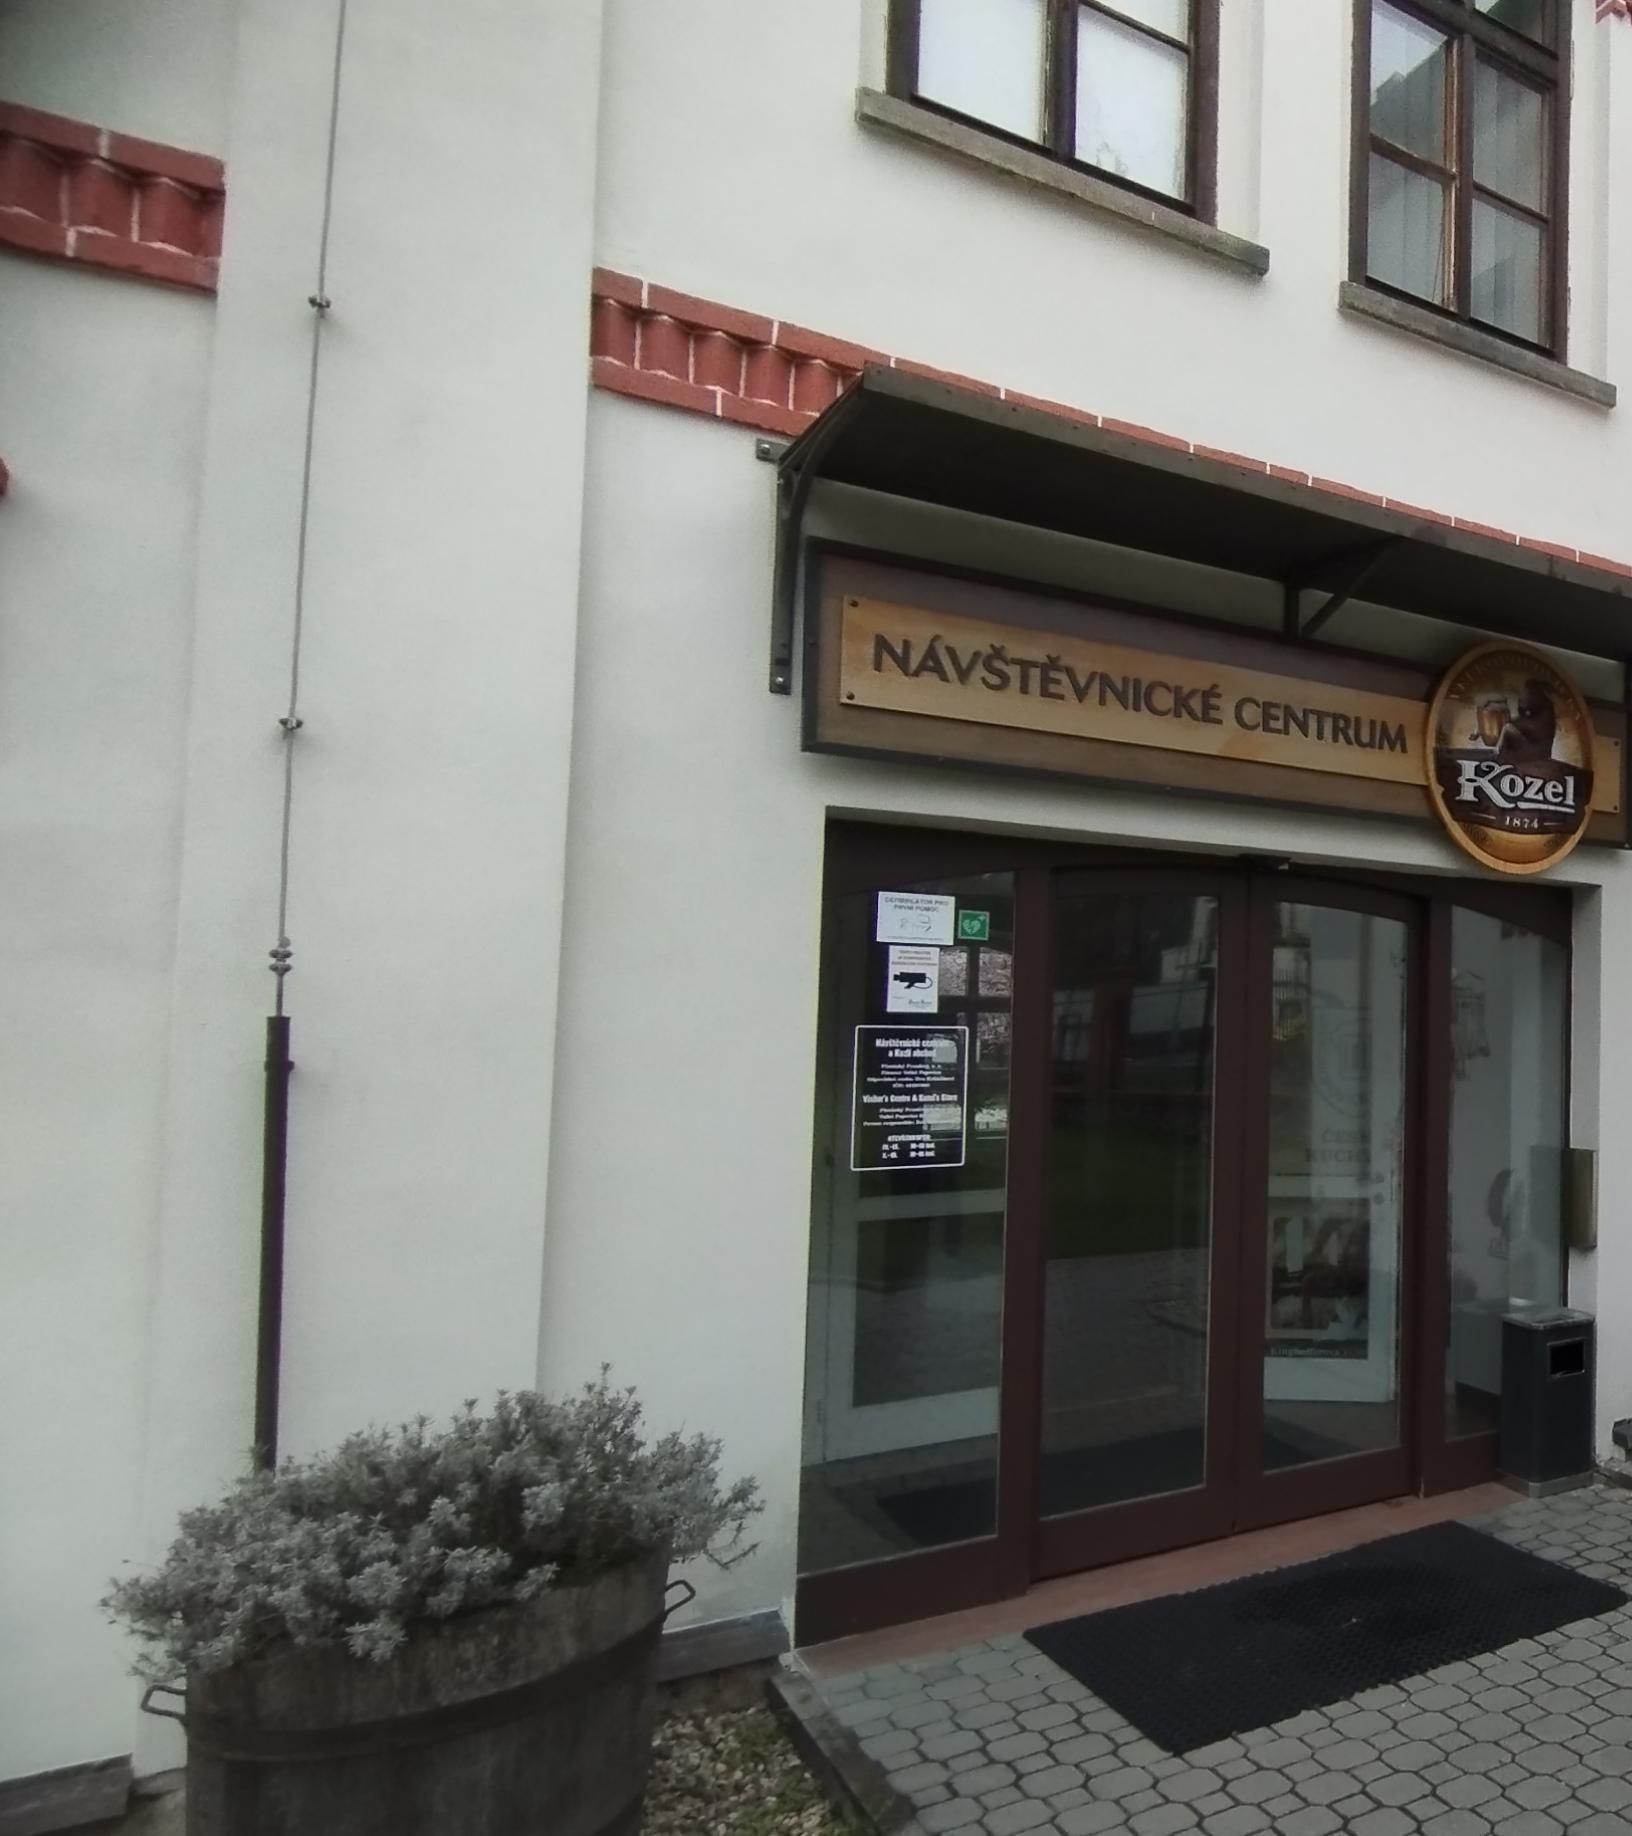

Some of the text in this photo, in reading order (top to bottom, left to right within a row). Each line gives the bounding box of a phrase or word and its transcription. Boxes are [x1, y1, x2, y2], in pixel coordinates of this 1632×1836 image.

[873, 634, 1407, 754] NÁVŠTĚVNICKÉ CENTRUM
[1456, 760, 1576, 812] Kozel
[1505, 816, 1538, 829] 1874
